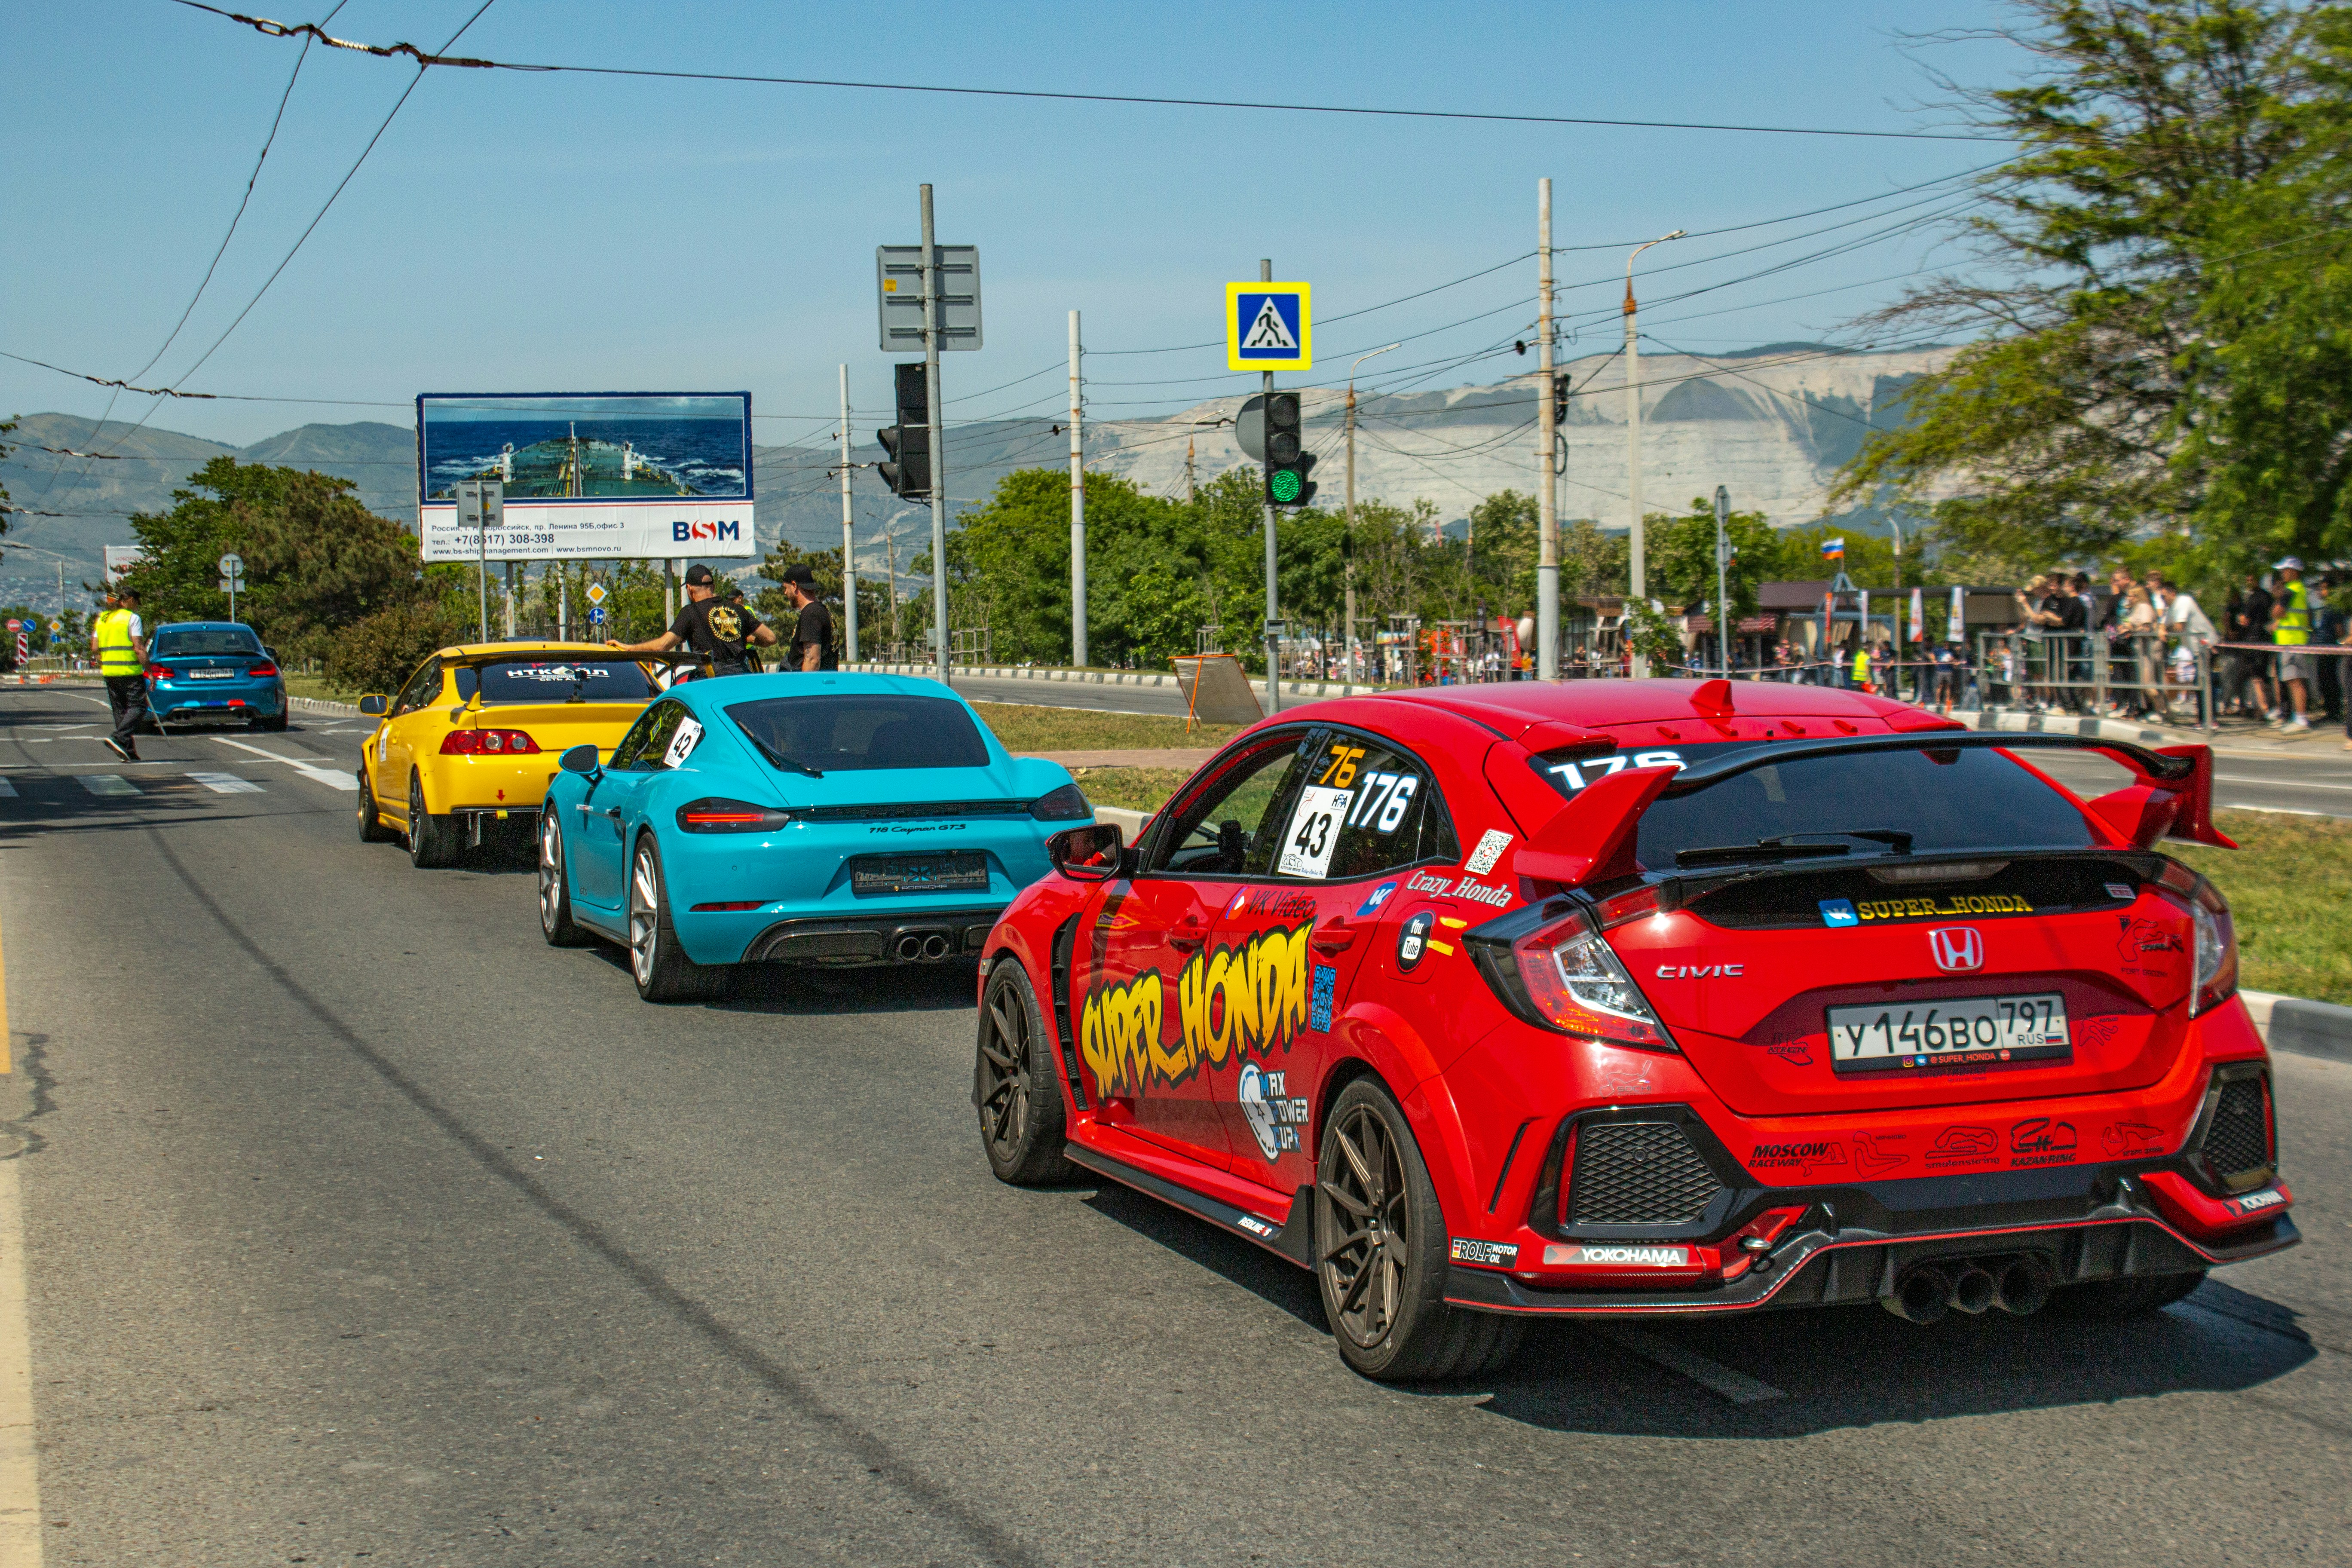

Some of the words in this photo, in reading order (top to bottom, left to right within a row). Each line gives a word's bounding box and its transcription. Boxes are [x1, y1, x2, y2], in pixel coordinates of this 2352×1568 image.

[473, 524, 531, 532] Нвороссийск,
[509, 534, 554, 544] 308-398
[673, 519, 740, 542] BSM
[673, 732, 692, 760] 42
[1320, 745, 1366, 788] 76
[1348, 772, 1418, 834] 176
[891, 826, 936, 835] Cayman
[1294, 812, 1332, 858] 43
[1406, 869, 1514, 908] Crazy_Honda
[1246, 891, 1270, 916] VK
[1271, 890, 1317, 919] Video
[1857, 895, 2034, 919] SUPER_HONDA
[1410, 919, 1424, 935] You
[1404, 940, 1418, 956] Tube
[1656, 965, 1744, 979] CIVIC
[1080, 920, 1315, 1103] SUPER_HONDA
[2001, 1000, 2054, 1034] 797
[2018, 1033, 2044, 1045] RUS
[1259, 1072, 1286, 1096] MAX
[1268, 1099, 1309, 1122] POWER
[1271, 1126, 1293, 1149] CUP
[1752, 1142, 1830, 1159] MOSCOW
[1747, 1158, 1803, 1168] RACEWAY
[1459, 1240, 1493, 1262] ROLF
[1492, 1244, 1518, 1256] MOTOR
[1490, 1254, 1501, 1264] OIL
[1582, 1248, 1681, 1263] YOKOHAMA
